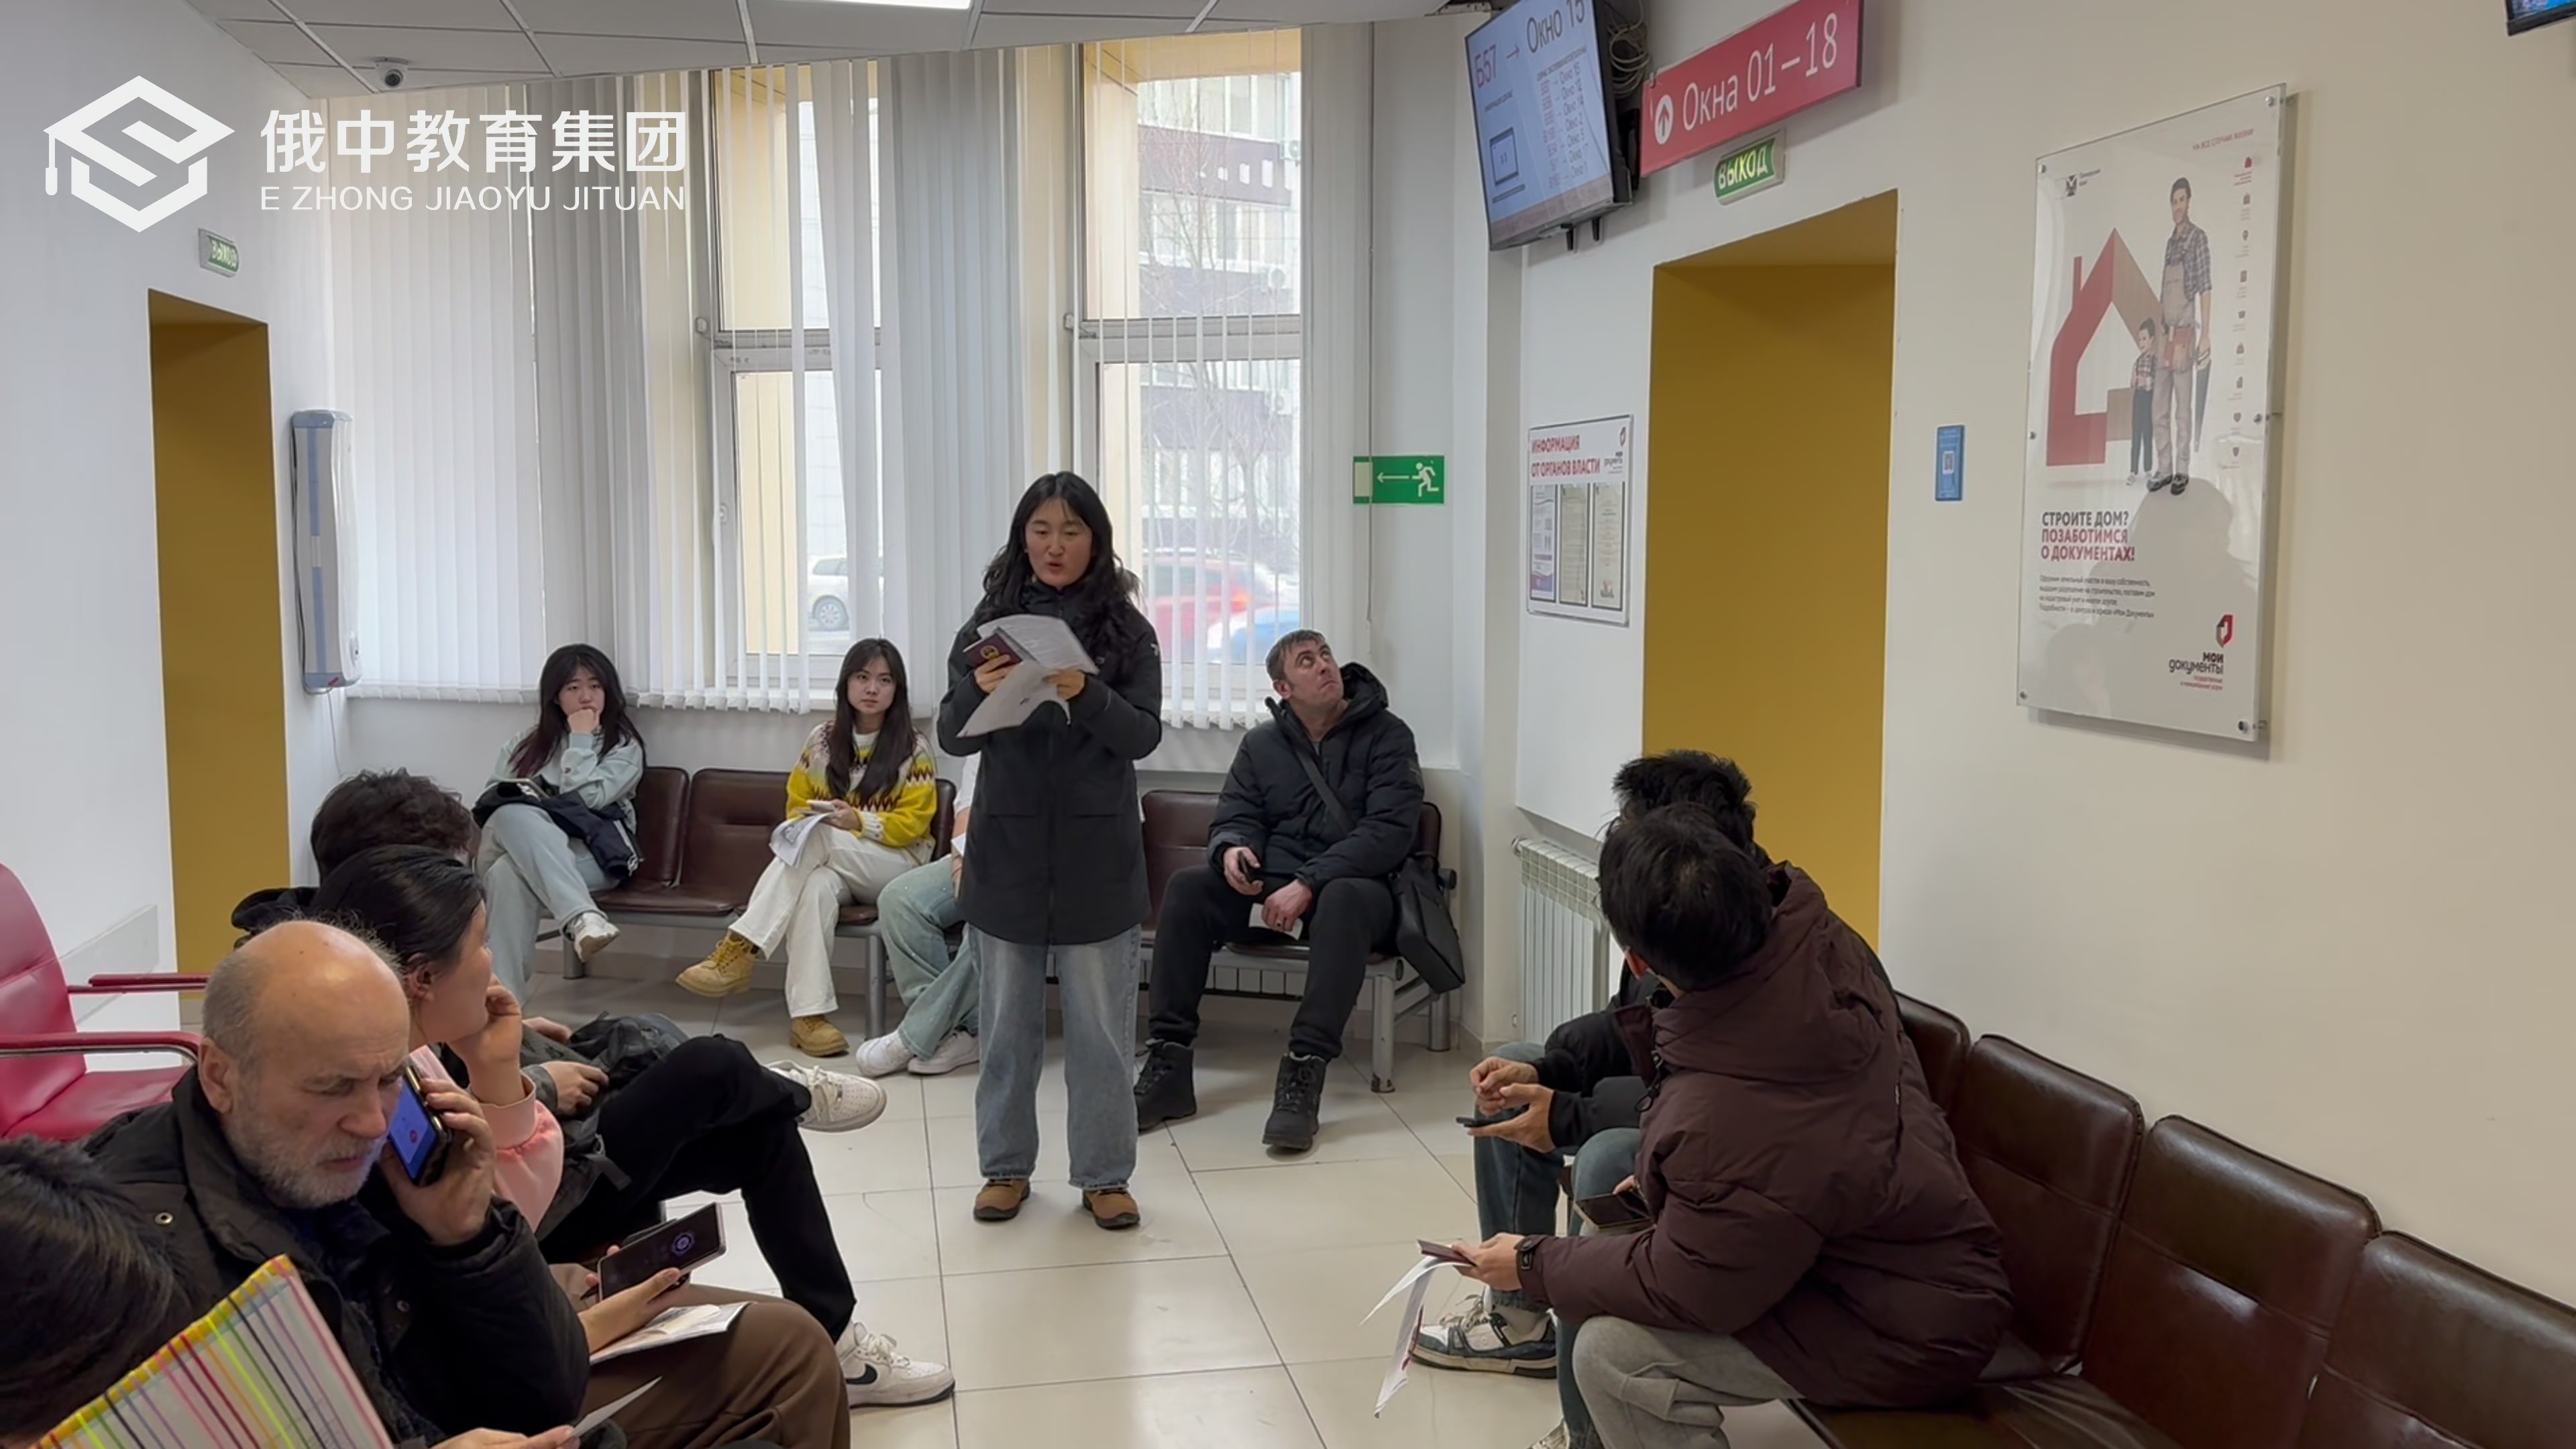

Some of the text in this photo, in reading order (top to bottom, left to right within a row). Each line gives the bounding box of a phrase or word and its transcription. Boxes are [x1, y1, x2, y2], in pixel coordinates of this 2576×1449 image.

[1474, 44, 1496, 88] Б57
[1526, 9, 1562, 54] Окно
[1682, 74, 1738, 131] Окна
[1718, 144, 1768, 189] ВЫХОД
[1532, 435, 1580, 454] ИНФОРМАЦИЯ
[1532, 462, 1540, 477] ОТ
[1540, 460, 1570, 476] ОРГАНОВ
[1572, 458, 1600, 475] ВЛАСТИ
[2042, 511, 2129, 528] СТРОИТЕ ДОМ?
[2041, 529, 2129, 543] ПОЗАБОТИМСЯ
[2041, 545, 2135, 561] О ДОКУМЕНТАХ!
